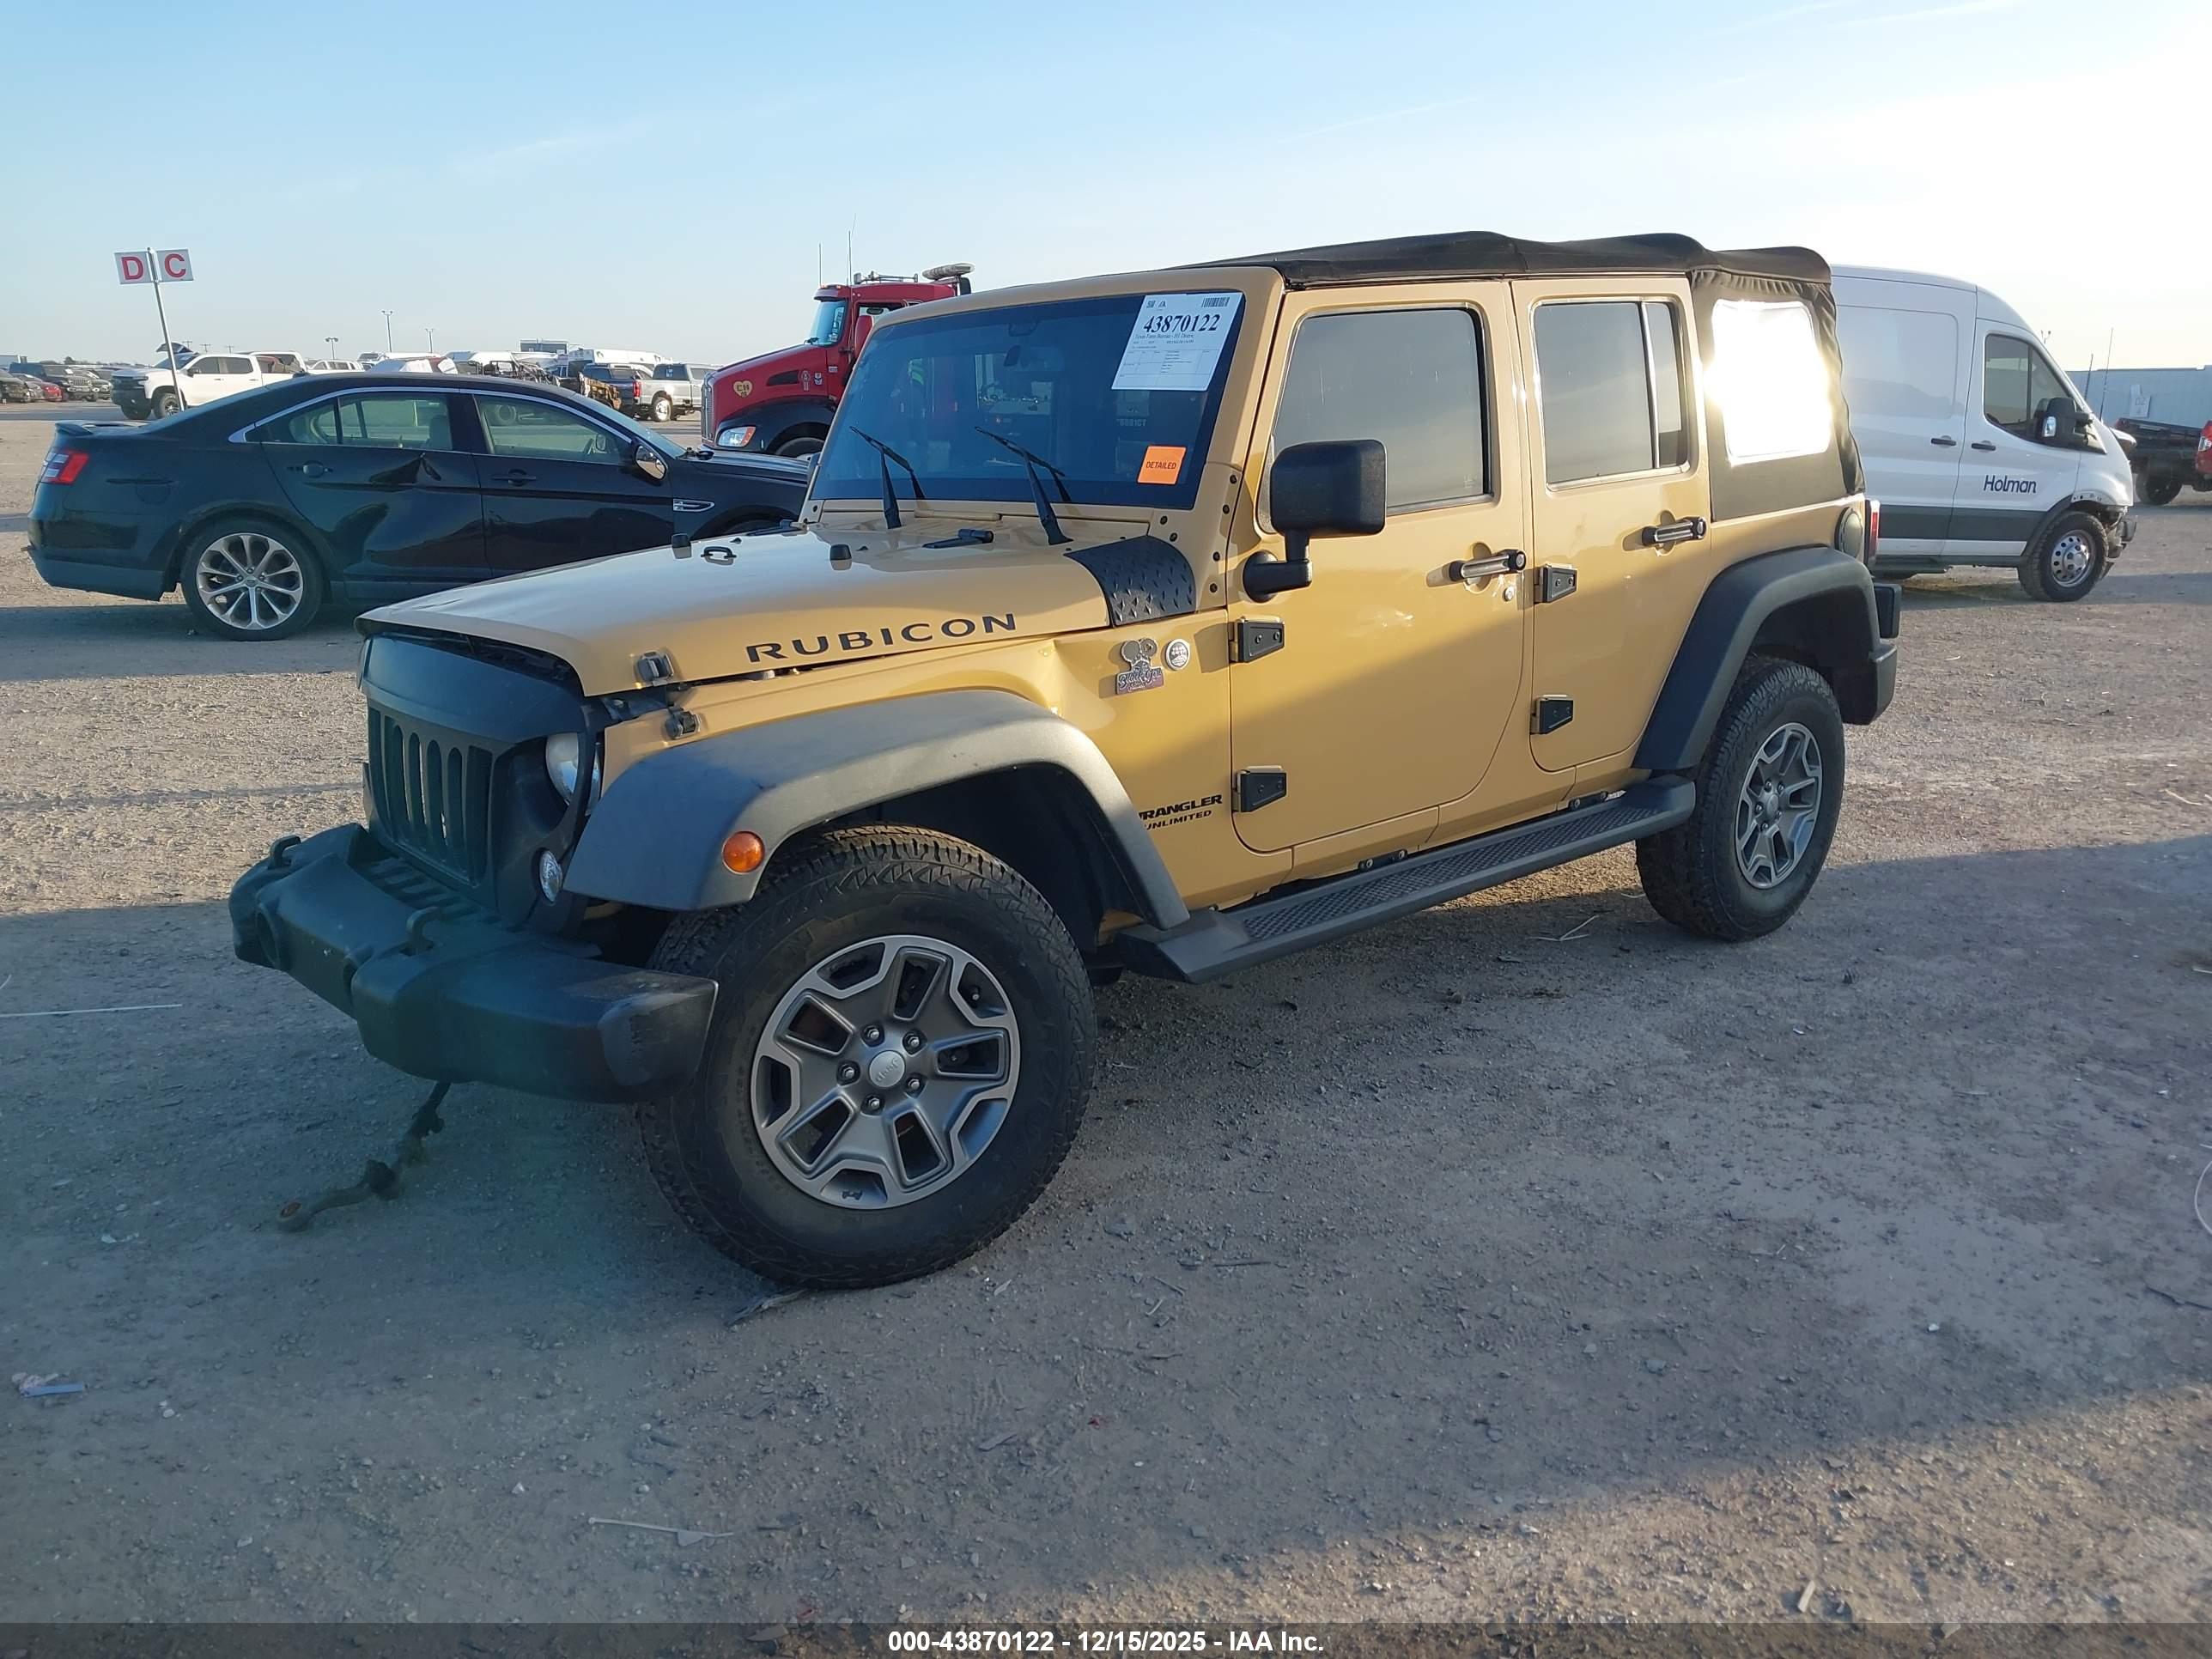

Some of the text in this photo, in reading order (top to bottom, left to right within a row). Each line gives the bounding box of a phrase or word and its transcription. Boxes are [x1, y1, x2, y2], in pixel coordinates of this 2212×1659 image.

[121, 256, 144, 280] D
[164, 253, 186, 278] C
[1143, 314, 1221, 333] 43870122
[1146, 460, 1177, 470] DETAILED
[1983, 474, 2037, 494] Holman
[745, 612, 1018, 664] RUBICON
